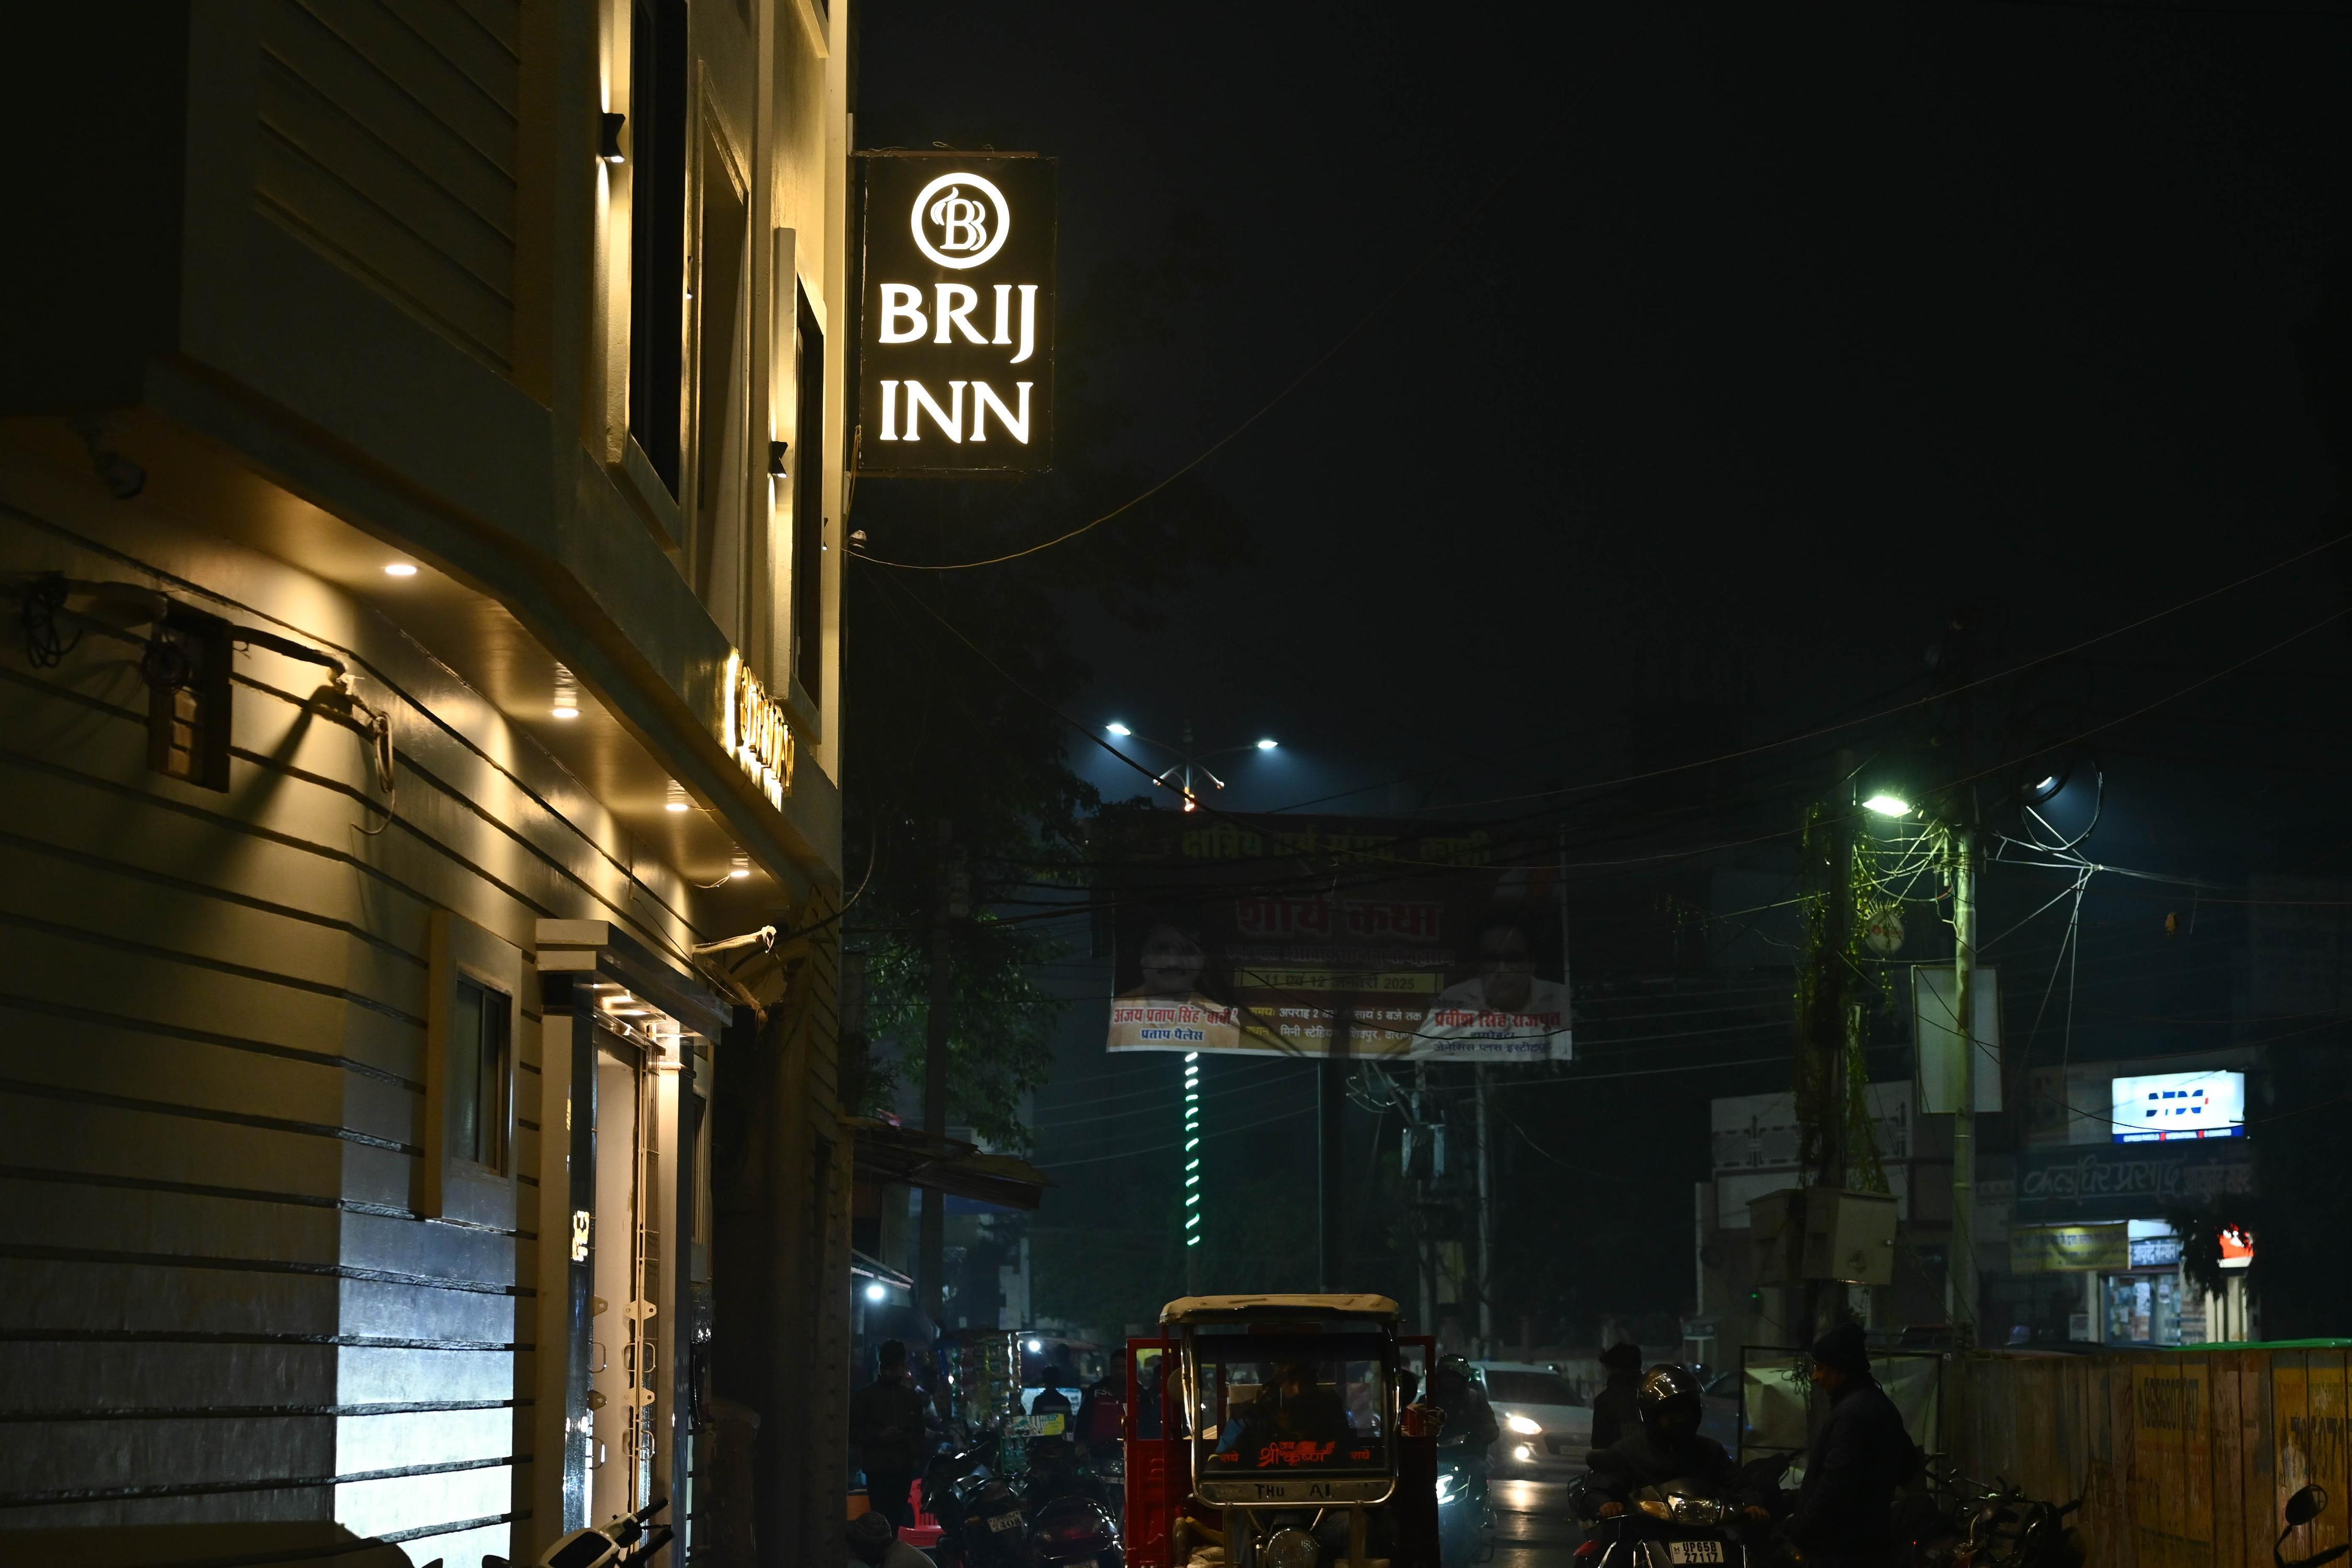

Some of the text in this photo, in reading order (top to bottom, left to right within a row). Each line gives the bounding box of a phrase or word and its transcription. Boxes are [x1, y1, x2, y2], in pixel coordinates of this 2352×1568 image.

[879, 283, 1038, 364] BRIJ
[880, 380, 1034, 445] INN
[1344, 900, 1441, 939] कथा
[1265, 974, 1277, 984] 11
[1310, 975, 1326, 988] 12
[1383, 977, 1415, 990] 2025
[1113, 1007, 1144, 1024] अजय
[1146, 1008, 1175, 1023] प्रताप
[1178, 1005, 1201, 1023] सिंह
[1313, 1008, 1319, 1019] 2
[1376, 1010, 1383, 1020] 5
[1386, 1009, 1402, 1021] बजे
[1405, 1011, 1423, 1021] तक
[1141, 1027, 1204, 1041] प्रताप पैलेस
[1279, 1023, 1301, 1037] मिनी
[1682, 1541, 1716, 1552] UP65B
